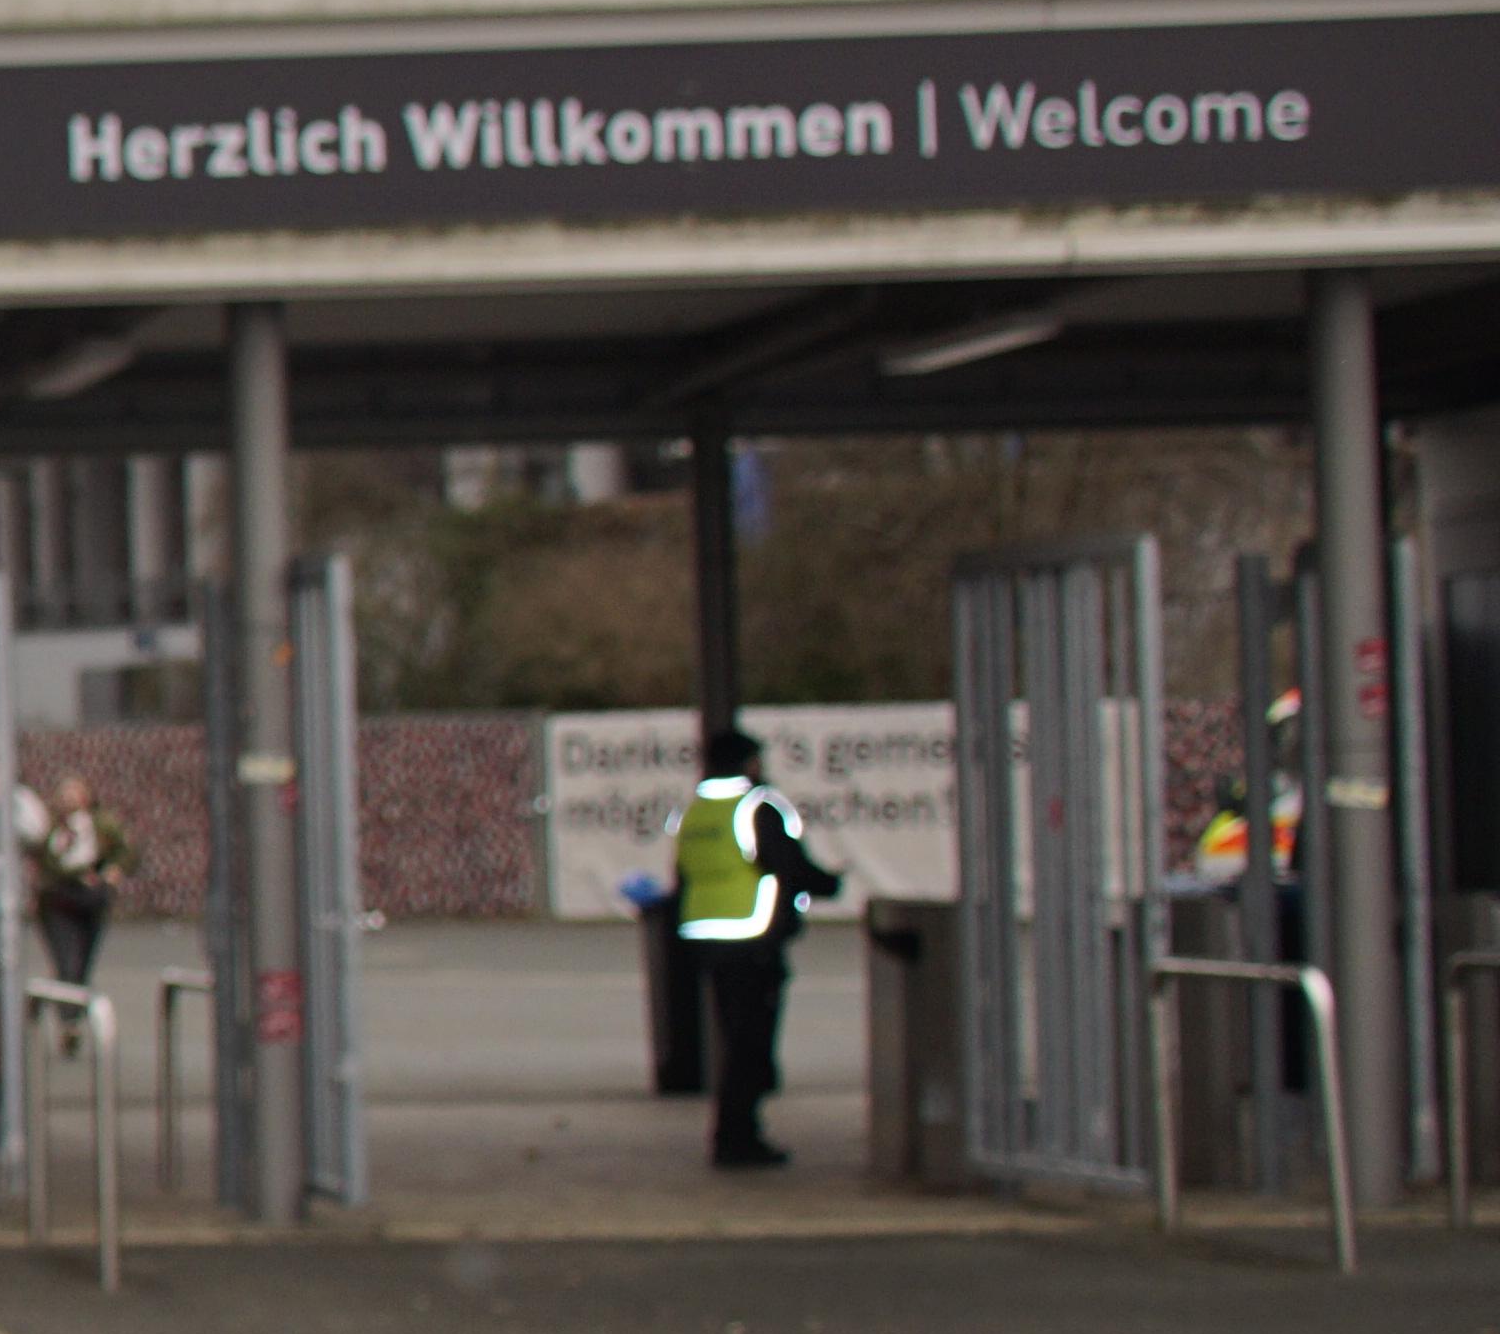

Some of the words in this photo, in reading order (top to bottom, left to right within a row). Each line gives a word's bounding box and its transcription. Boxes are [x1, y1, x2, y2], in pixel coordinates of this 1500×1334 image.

[67, 104, 388, 184] Herzlich
[402, 97, 896, 171] Willkommen
[957, 79, 1312, 151] Welcome
